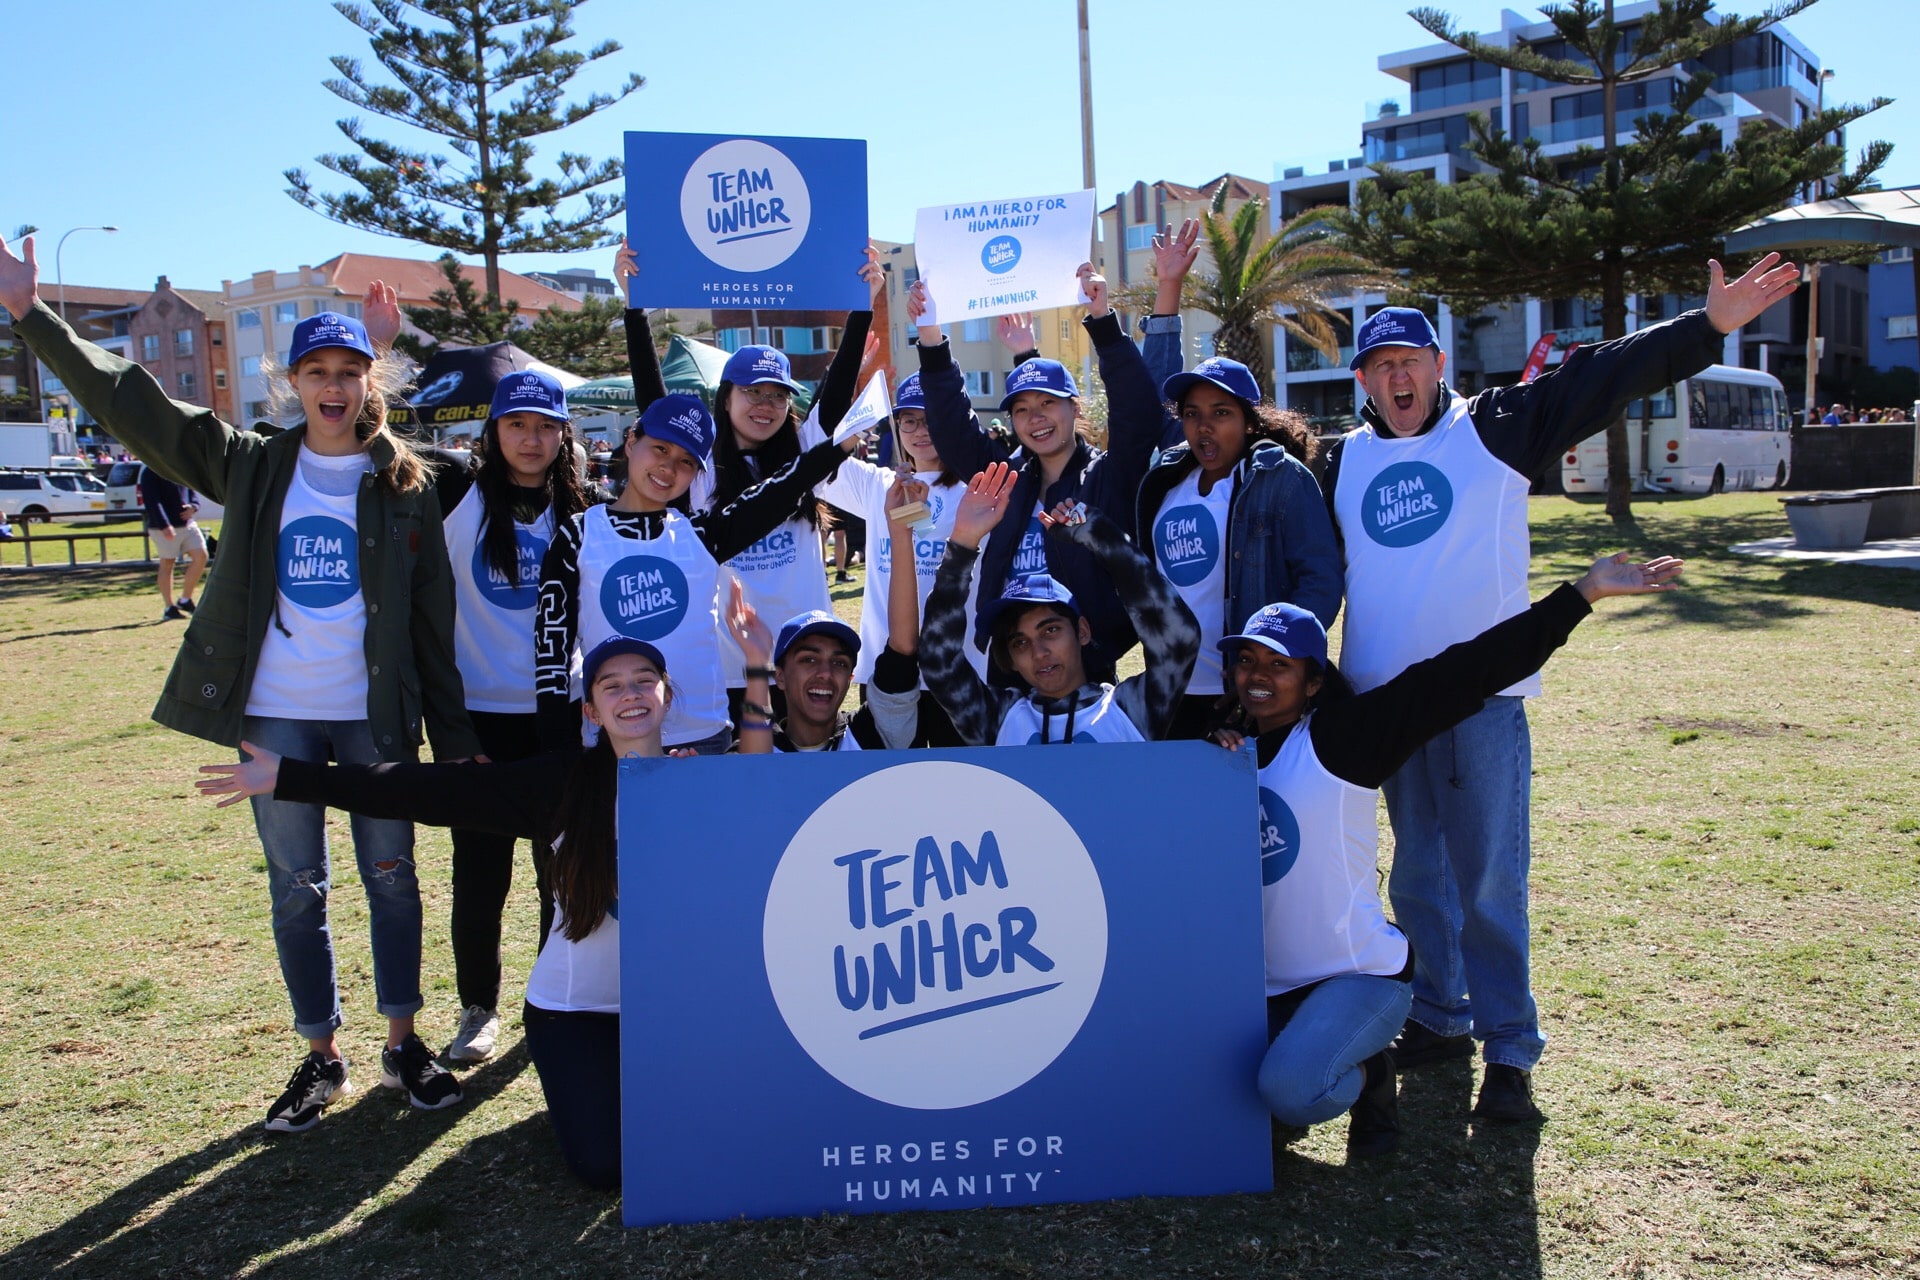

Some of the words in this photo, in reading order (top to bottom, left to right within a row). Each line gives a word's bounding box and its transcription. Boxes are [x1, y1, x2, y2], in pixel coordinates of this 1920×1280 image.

[707, 167, 774, 203] TEAM
[707, 197, 791, 234] UNHCR
[944, 209, 949, 221] I
[952, 206, 976, 220] AM
[979, 204, 989, 217] A
[993, 200, 1033, 216] HERO
[1036, 197, 1067, 212] FOR
[988, 249, 1016, 265] UNHCR
[990, 241, 1011, 255] TEAM
[703, 283, 759, 292] HEROES
[767, 283, 794, 292] FOR
[711, 296, 787, 305] HUMANITY
[967, 289, 1038, 311] #TEAMUNHCR
[314, 325, 346, 333] UNHCR
[1370, 320, 1397, 335] UNHCR
[758, 359, 781, 368] UNHCR
[1017, 370, 1041, 382] UNHCR
[516, 385, 544, 393] UNHCR
[434, 404, 491, 422] can-a
[680, 414, 702, 434] UNHCR
[1376, 475, 1425, 506] TEAM
[1376, 493, 1439, 527] UNHCR
[1165, 517, 1197, 541] TEAM
[293, 535, 342, 557] TEAM
[1164, 537, 1206, 561] UNHCR
[287, 556, 351, 580] UNHCR
[616, 569, 664, 597] TEAM
[617, 587, 677, 618] UNHCR
[833, 829, 1009, 931] TEAM
[833, 906, 1055, 1012] UNHCR
[823, 1140, 970, 1167] HEROES
[994, 1135, 1063, 1158] FOR
[846, 1172, 1042, 1202] HUMANITY
